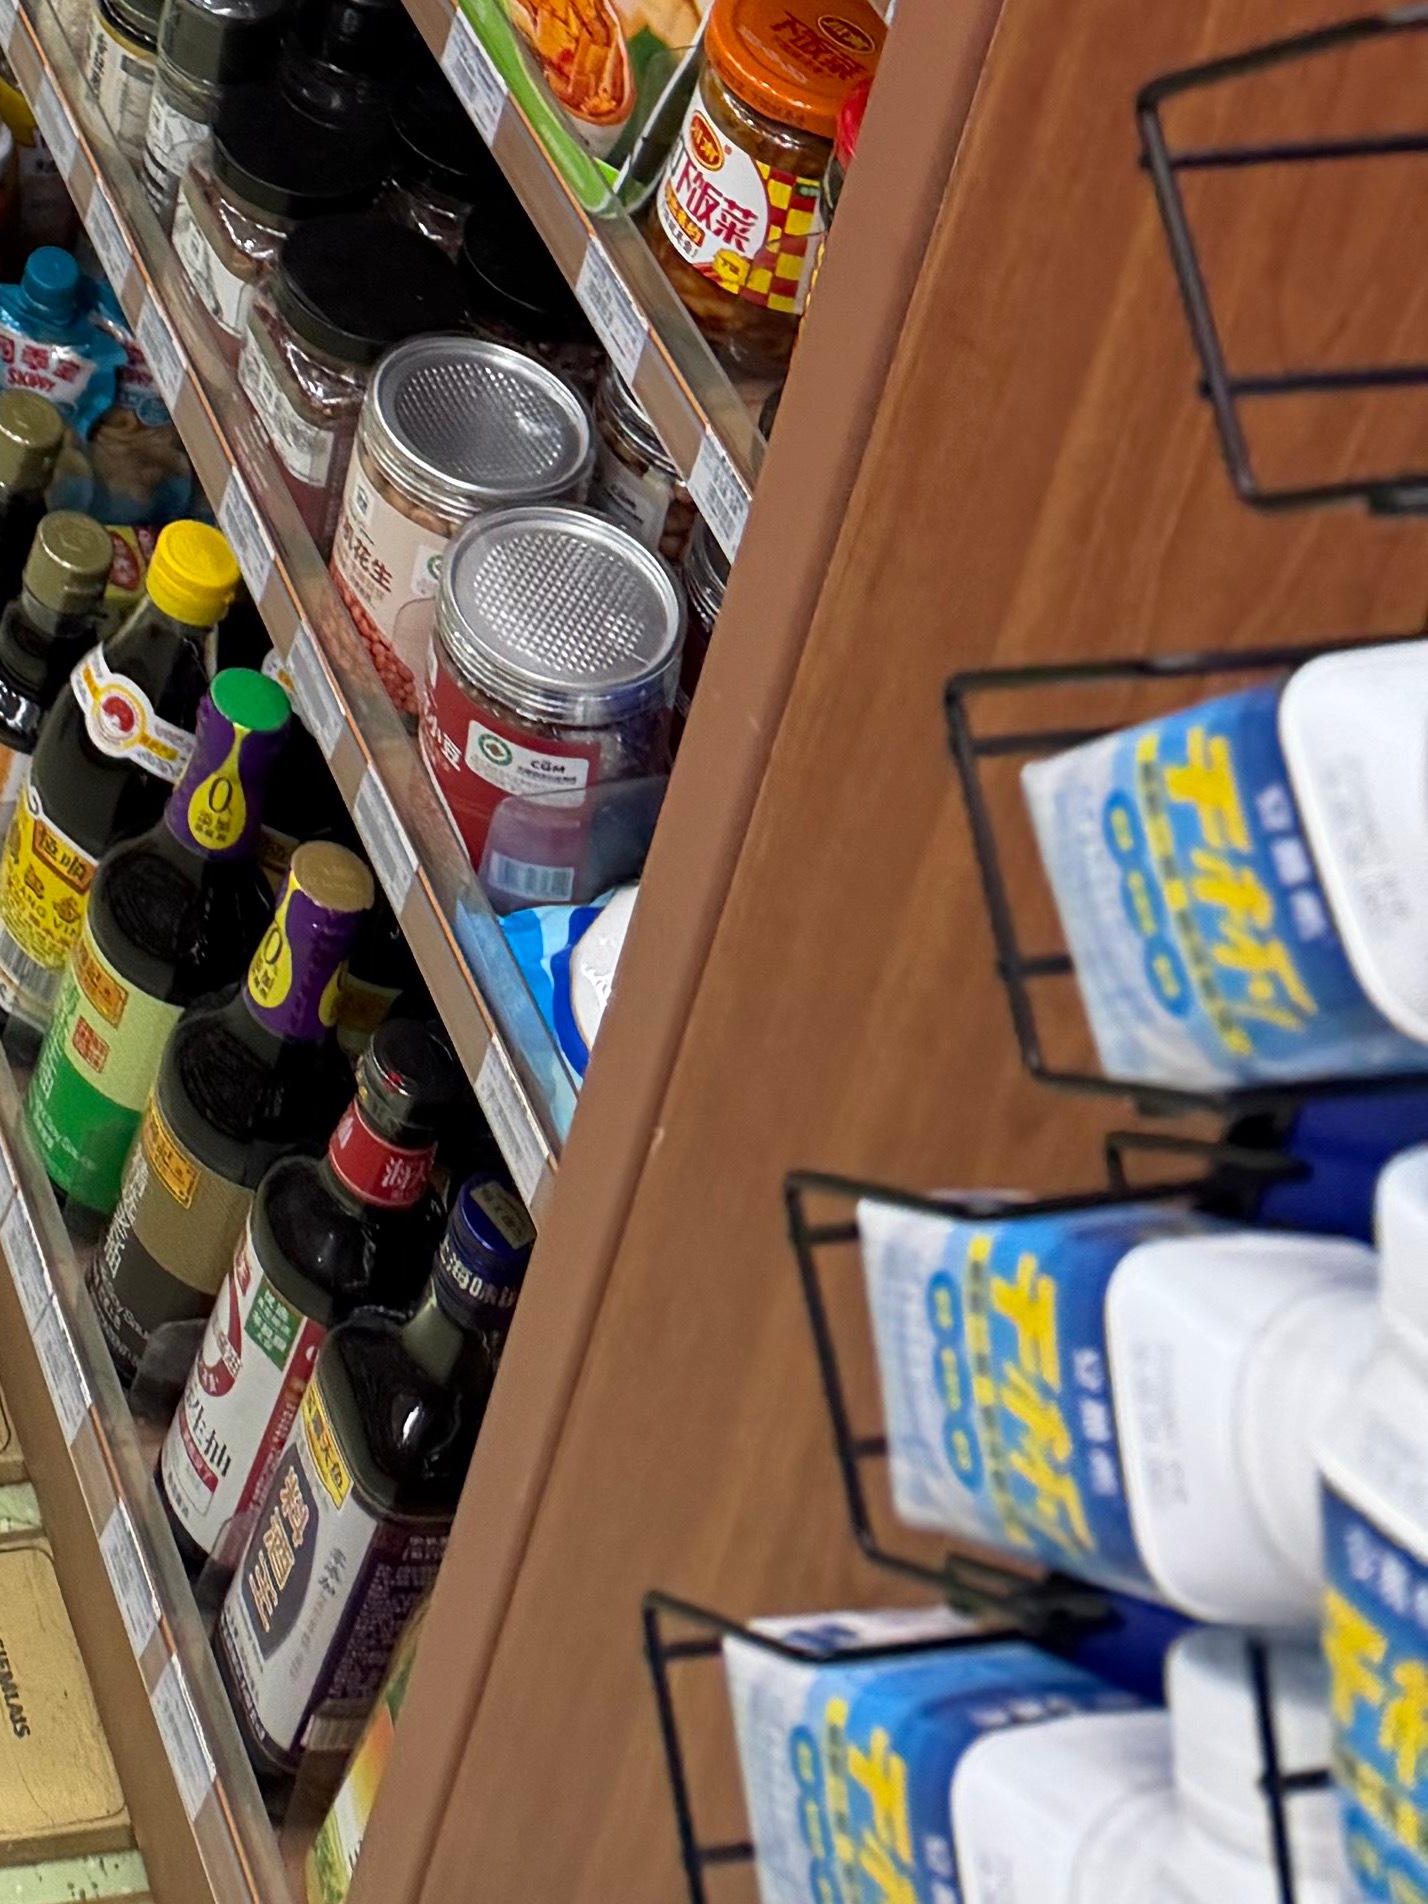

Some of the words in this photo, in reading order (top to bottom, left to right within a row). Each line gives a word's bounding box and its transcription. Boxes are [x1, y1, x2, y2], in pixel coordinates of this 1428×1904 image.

[675, 148, 759, 255] 下饭菜
[8, 366, 56, 394] SKIPPY
[208, 778, 234, 815] 0
[260, 930, 283, 966] 0
